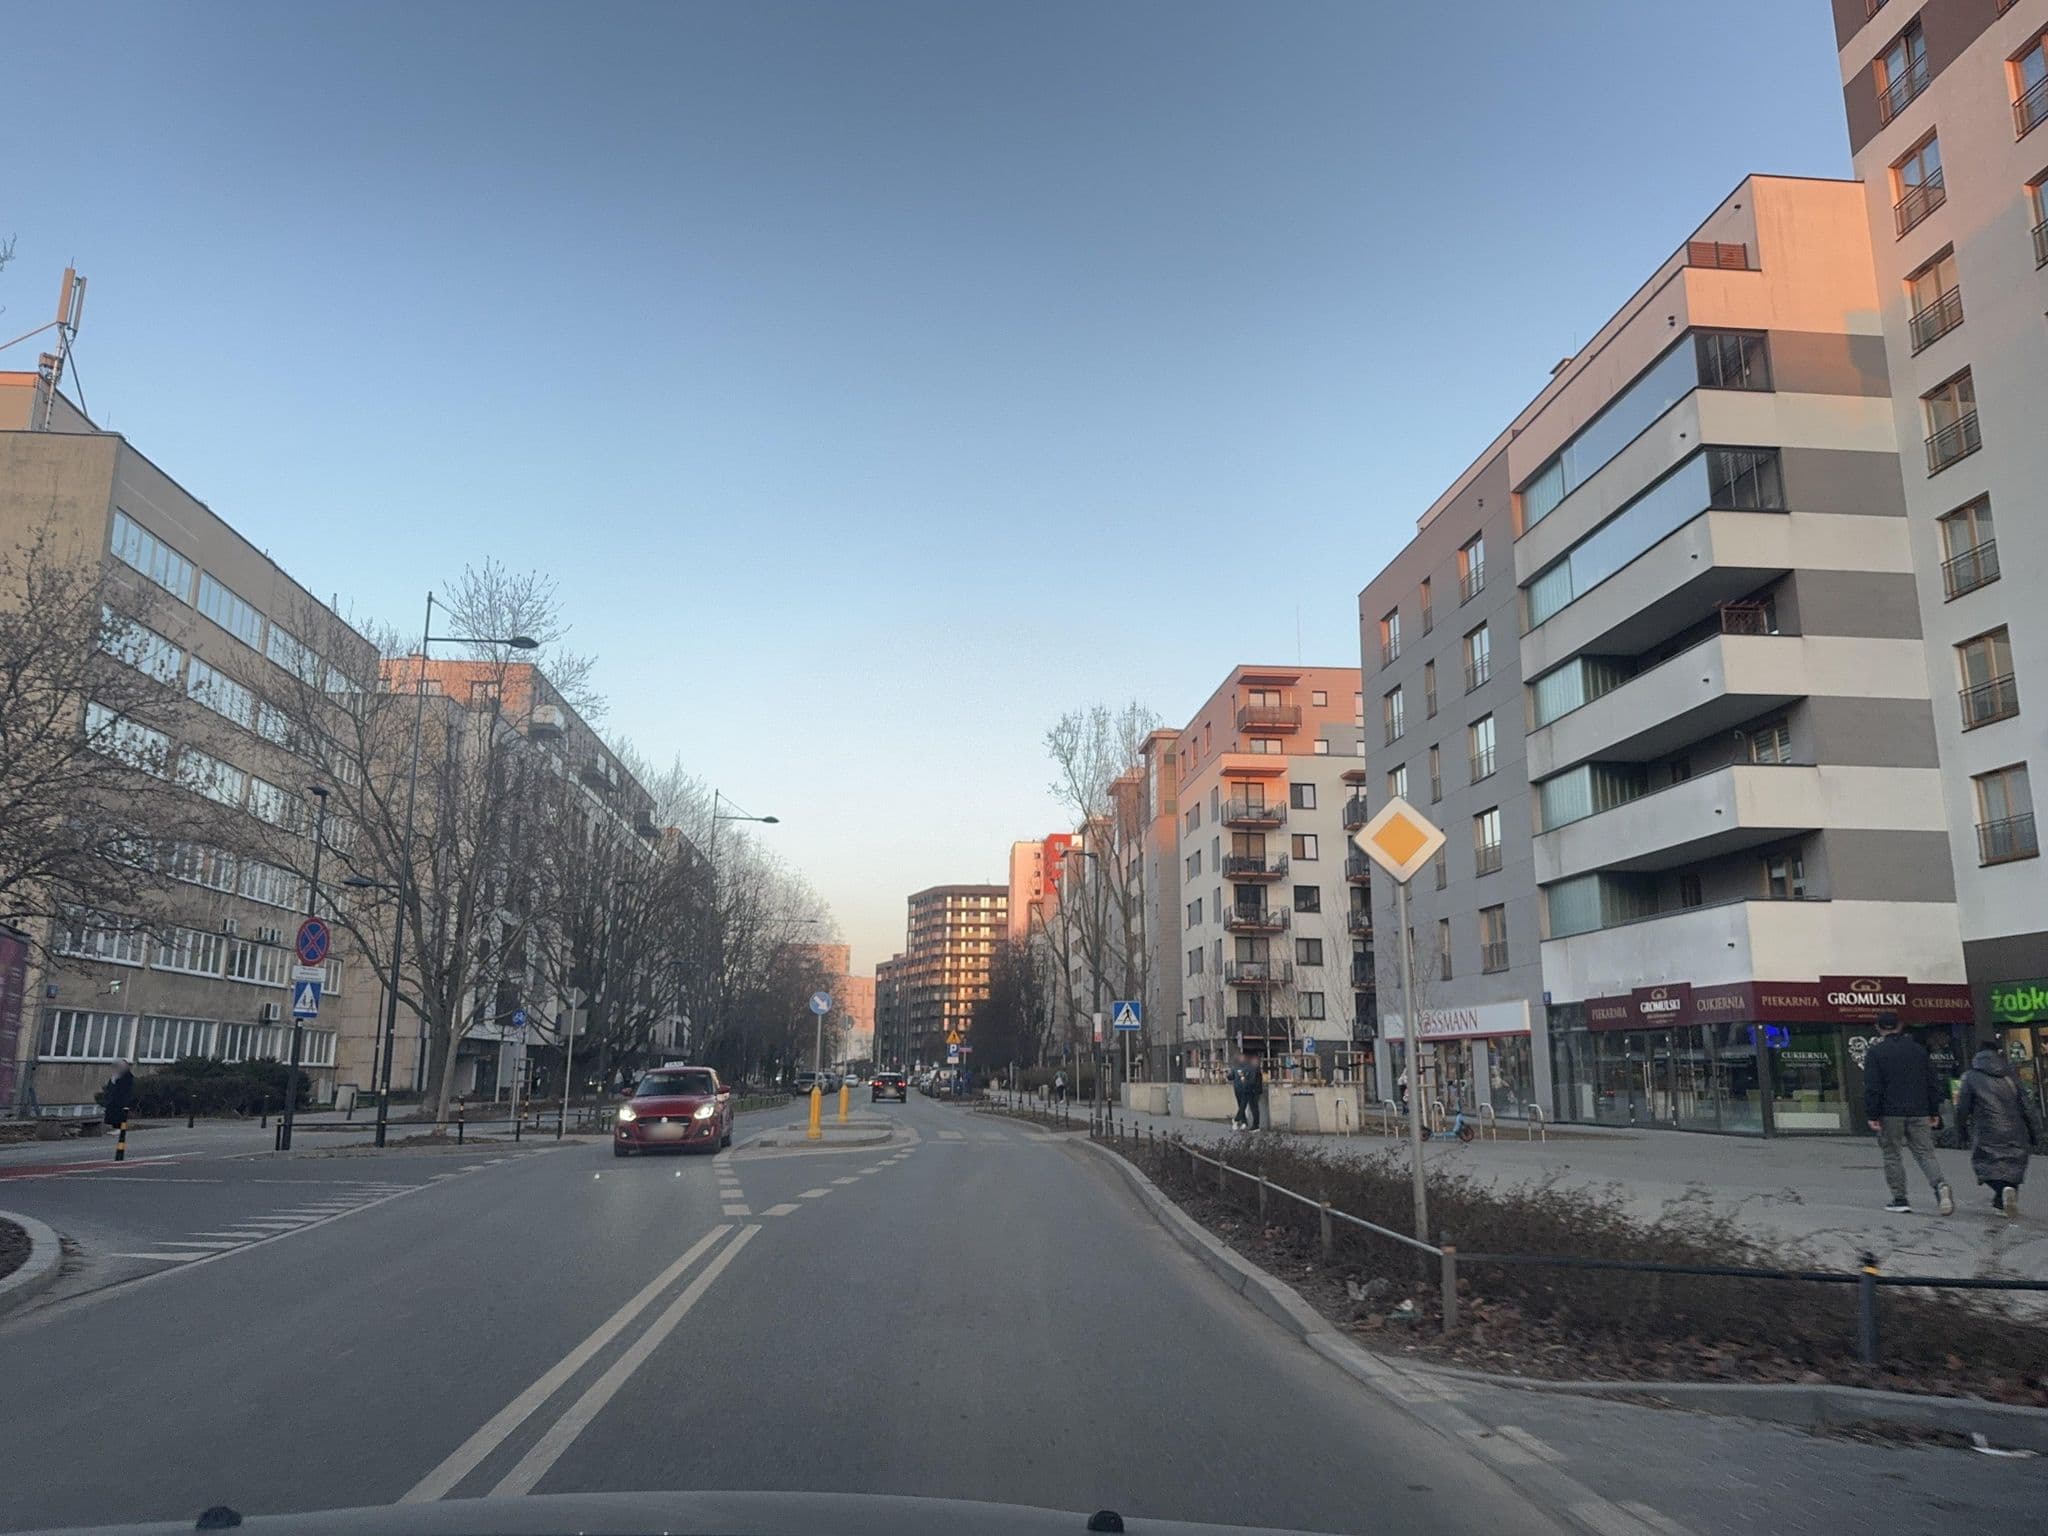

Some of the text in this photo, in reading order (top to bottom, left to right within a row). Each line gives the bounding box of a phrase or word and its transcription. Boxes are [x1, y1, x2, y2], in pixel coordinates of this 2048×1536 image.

[1591, 996, 1745, 1021] PIEKARNIA GROMULSKI CUKIERNIA
[1761, 992, 1972, 1009] PIEKARNIA GROMULSKI CUKIERNIA
[1991, 987, 2048, 1012] żabk
